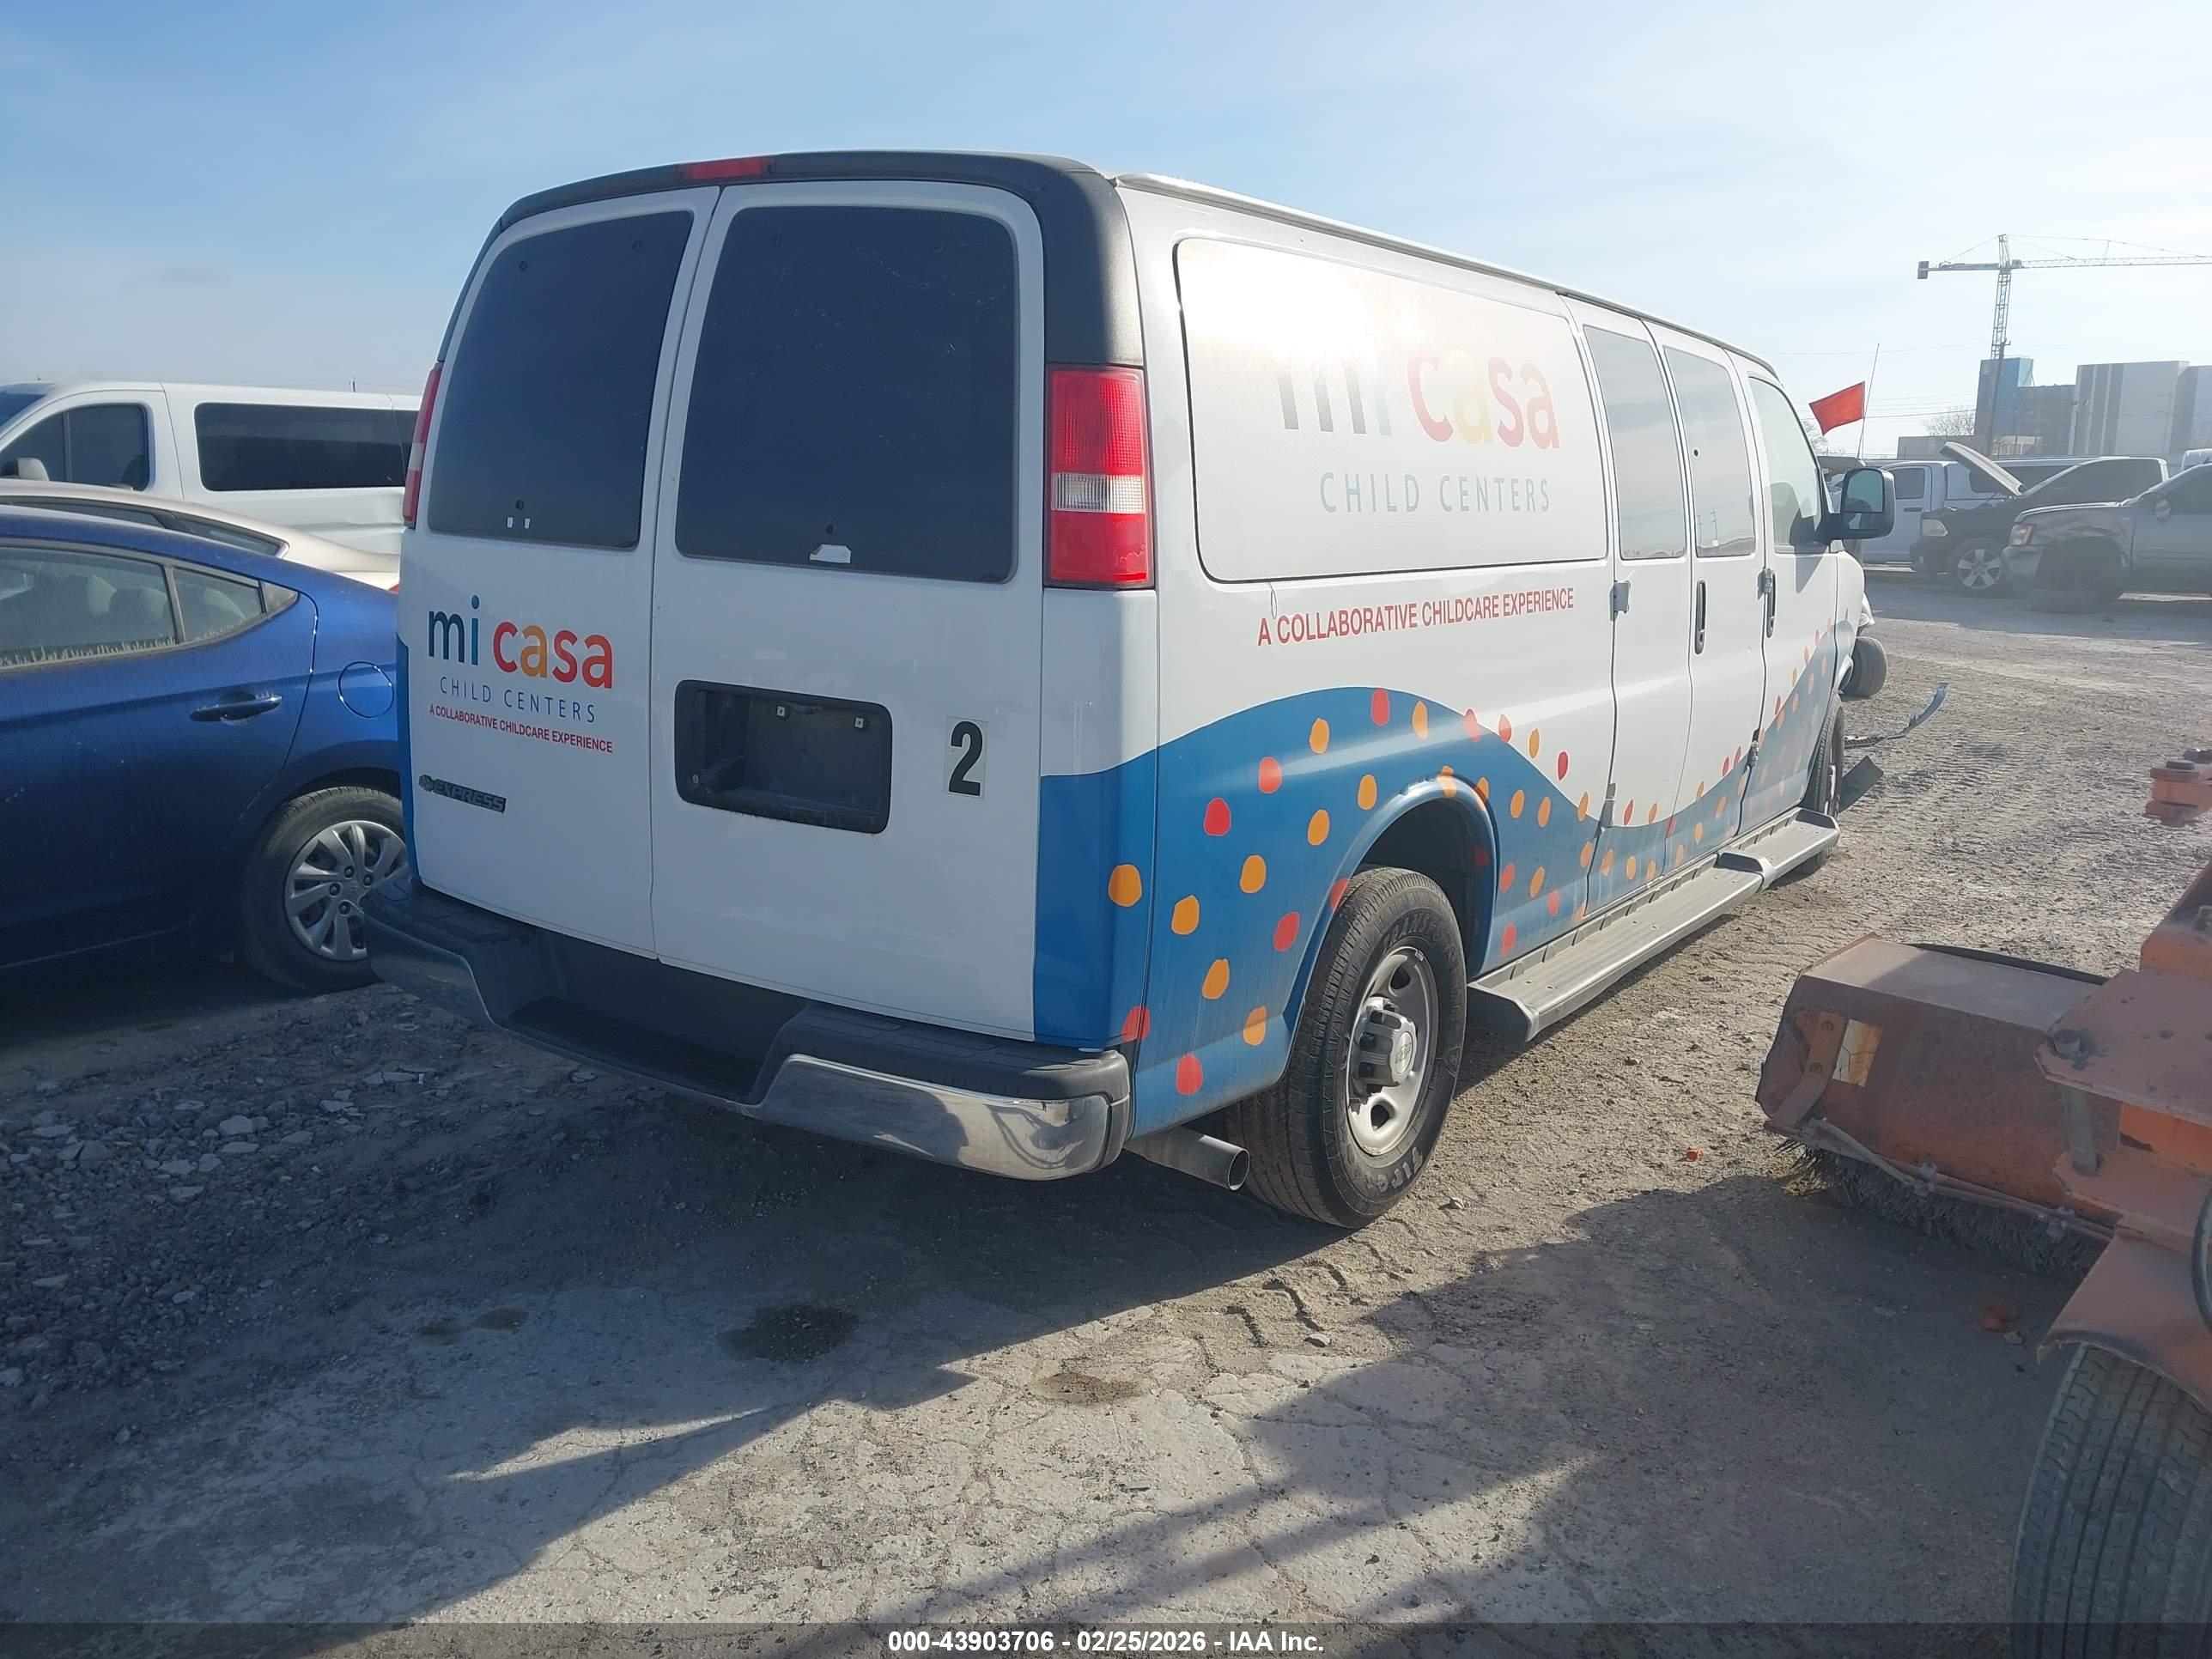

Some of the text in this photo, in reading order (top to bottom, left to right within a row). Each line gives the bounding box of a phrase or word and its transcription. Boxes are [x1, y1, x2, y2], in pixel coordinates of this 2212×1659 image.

[1407, 343, 1559, 449] casa
[1320, 471, 1550, 513] CHILD CENTERS
[428, 595, 612, 689] mi casa
[1258, 587, 1574, 646] A COLLABORATIVE CHILDCARE EXPERIENCE
[440, 676, 595, 723] CHILD CENTERS
[429, 704, 613, 753] A COLLABORATIVE CHILDCARE EXPERIENCE
[948, 720, 984, 797] 2
[433, 780, 505, 812] EXPRESS
